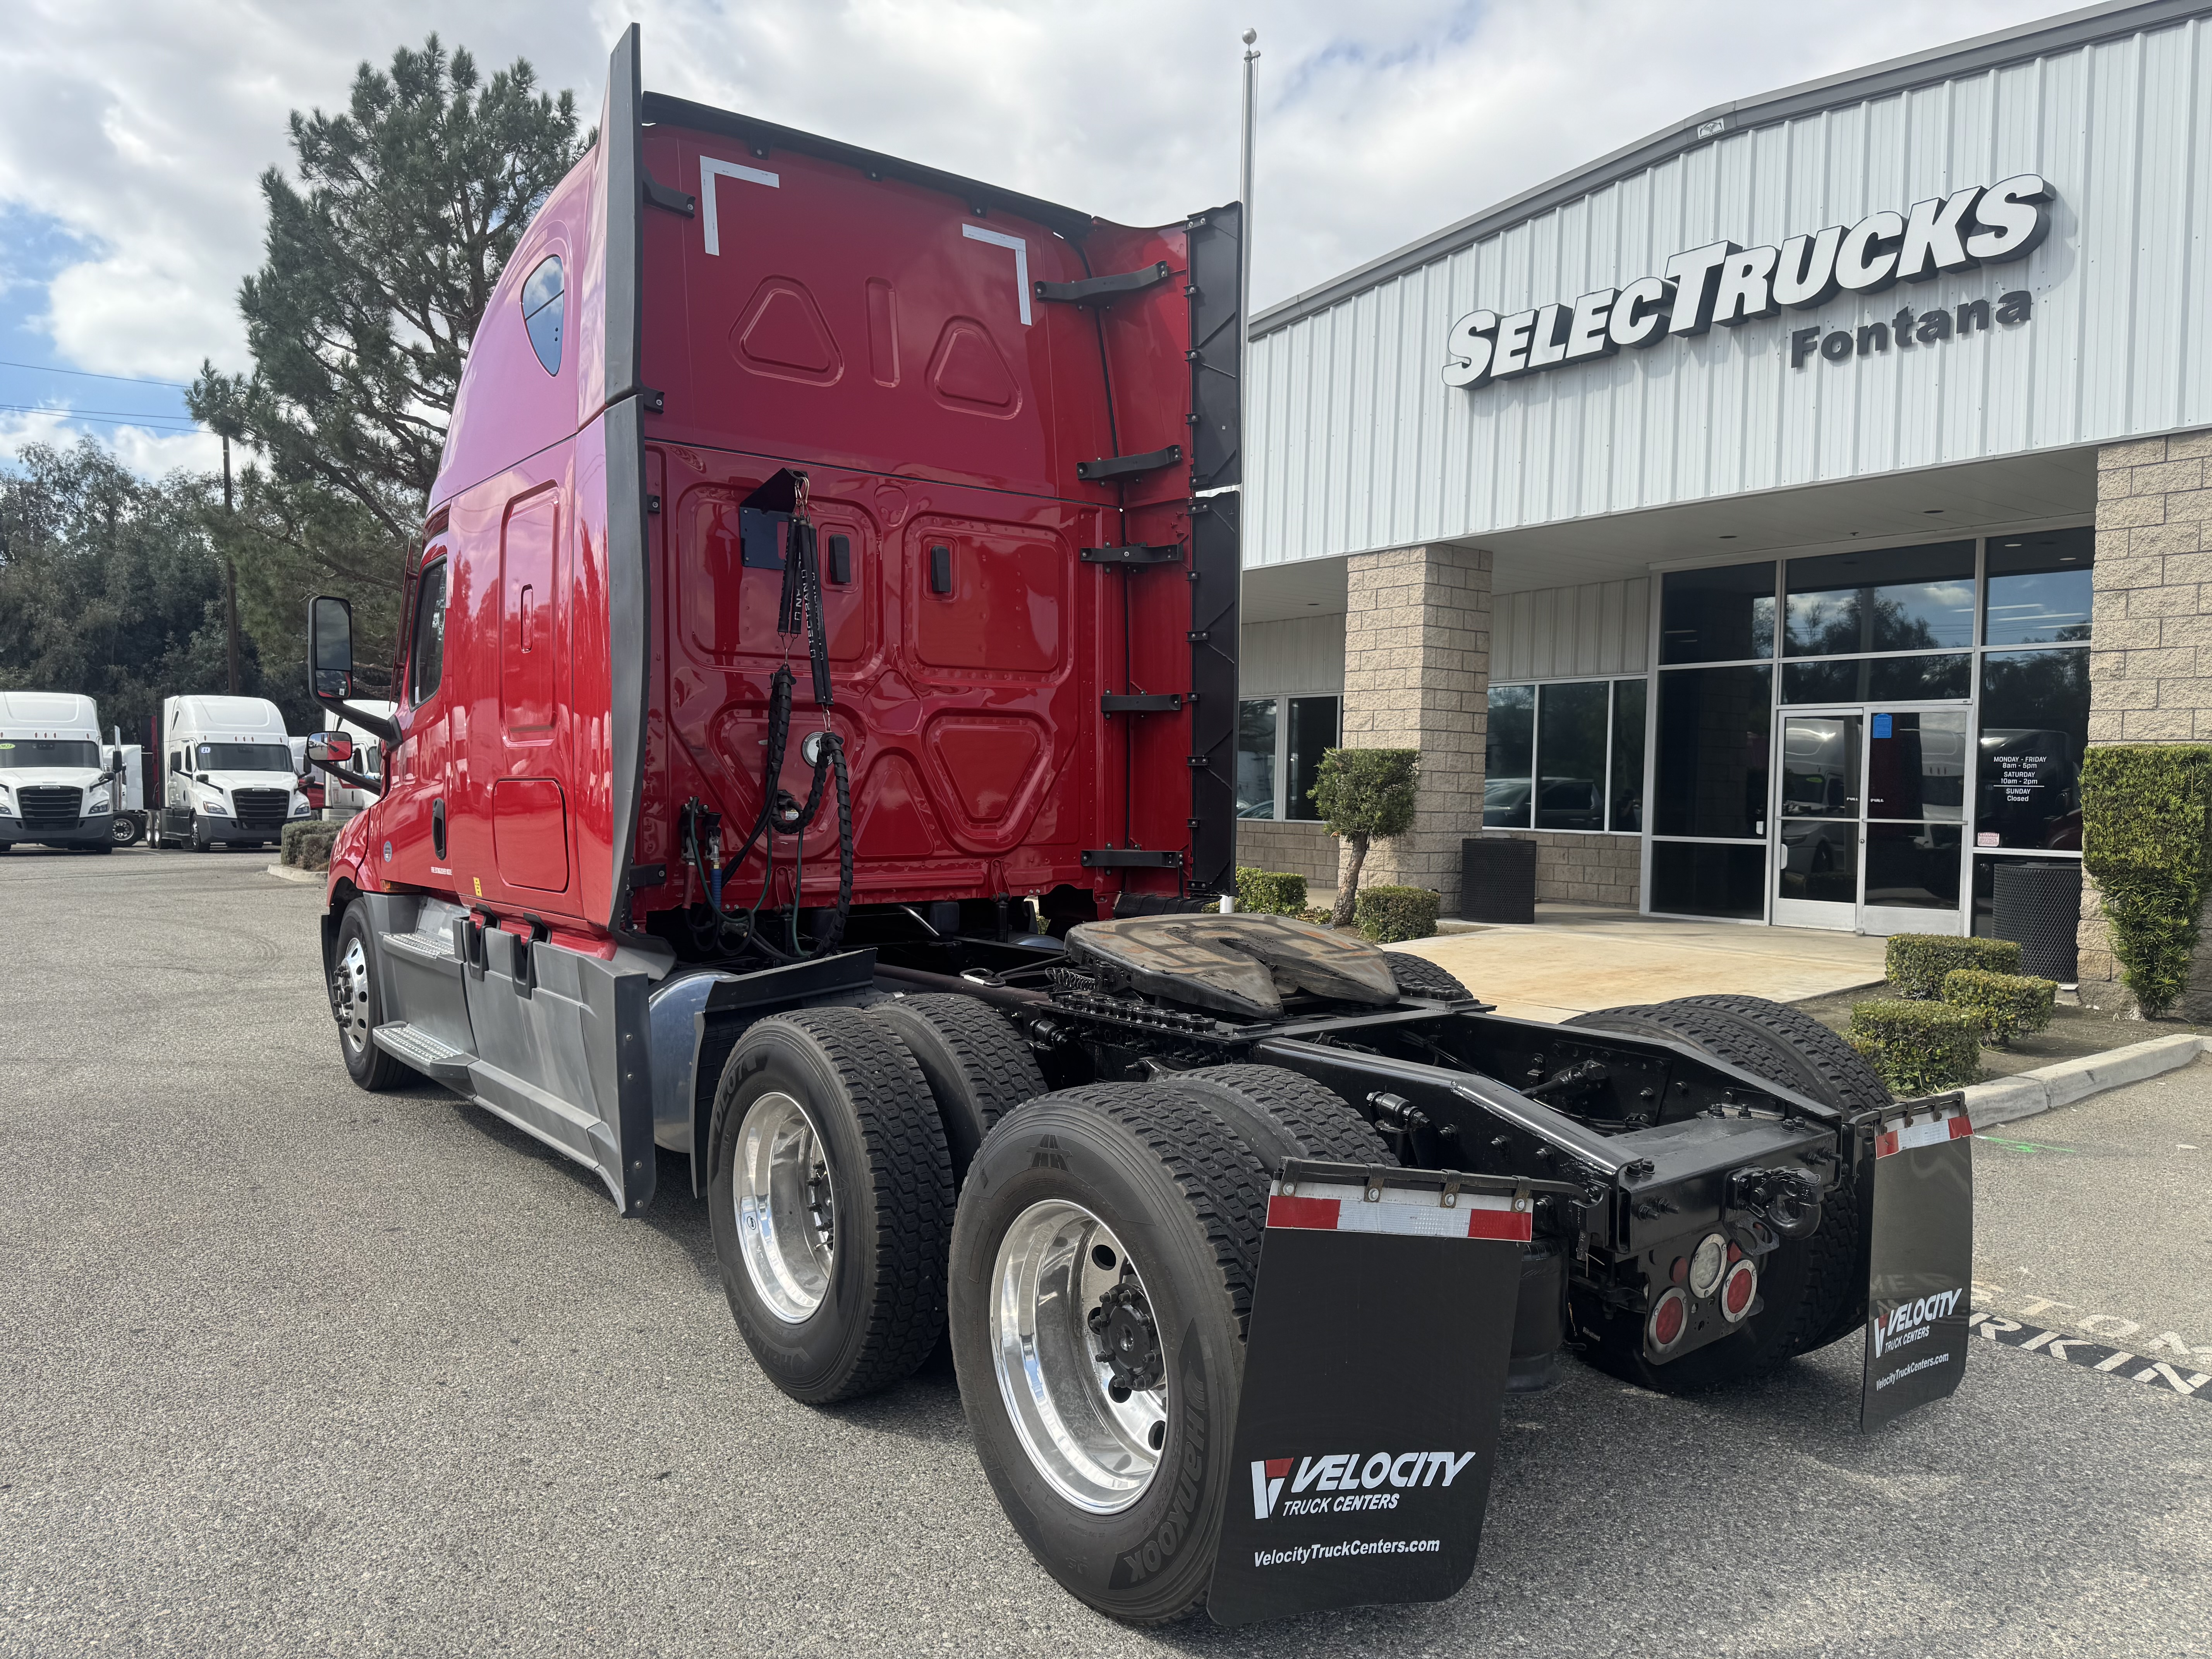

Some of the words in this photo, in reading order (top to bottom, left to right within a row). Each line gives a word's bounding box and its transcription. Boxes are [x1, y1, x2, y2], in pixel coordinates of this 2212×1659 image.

[1442, 173, 2054, 390] SELECTRUCKS
[1791, 290, 2032, 369] Fontana
[803, 583, 814, 646] TECTRAN
[1887, 1288, 1963, 1336] VELOCITY
[1885, 1335, 1902, 1353] TRUCK
[1903, 1325, 1930, 1345] CENTERS
[1876, 1353, 1949, 1391] VelocityTruckCenters.com
[1291, 1451, 1476, 1493] VELOCITY
[1283, 1497, 1332, 1516] TRUCK
[1333, 1493, 1400, 1513] CENTERS
[1254, 1539, 1440, 1568] VelocityTruckCenters.com
